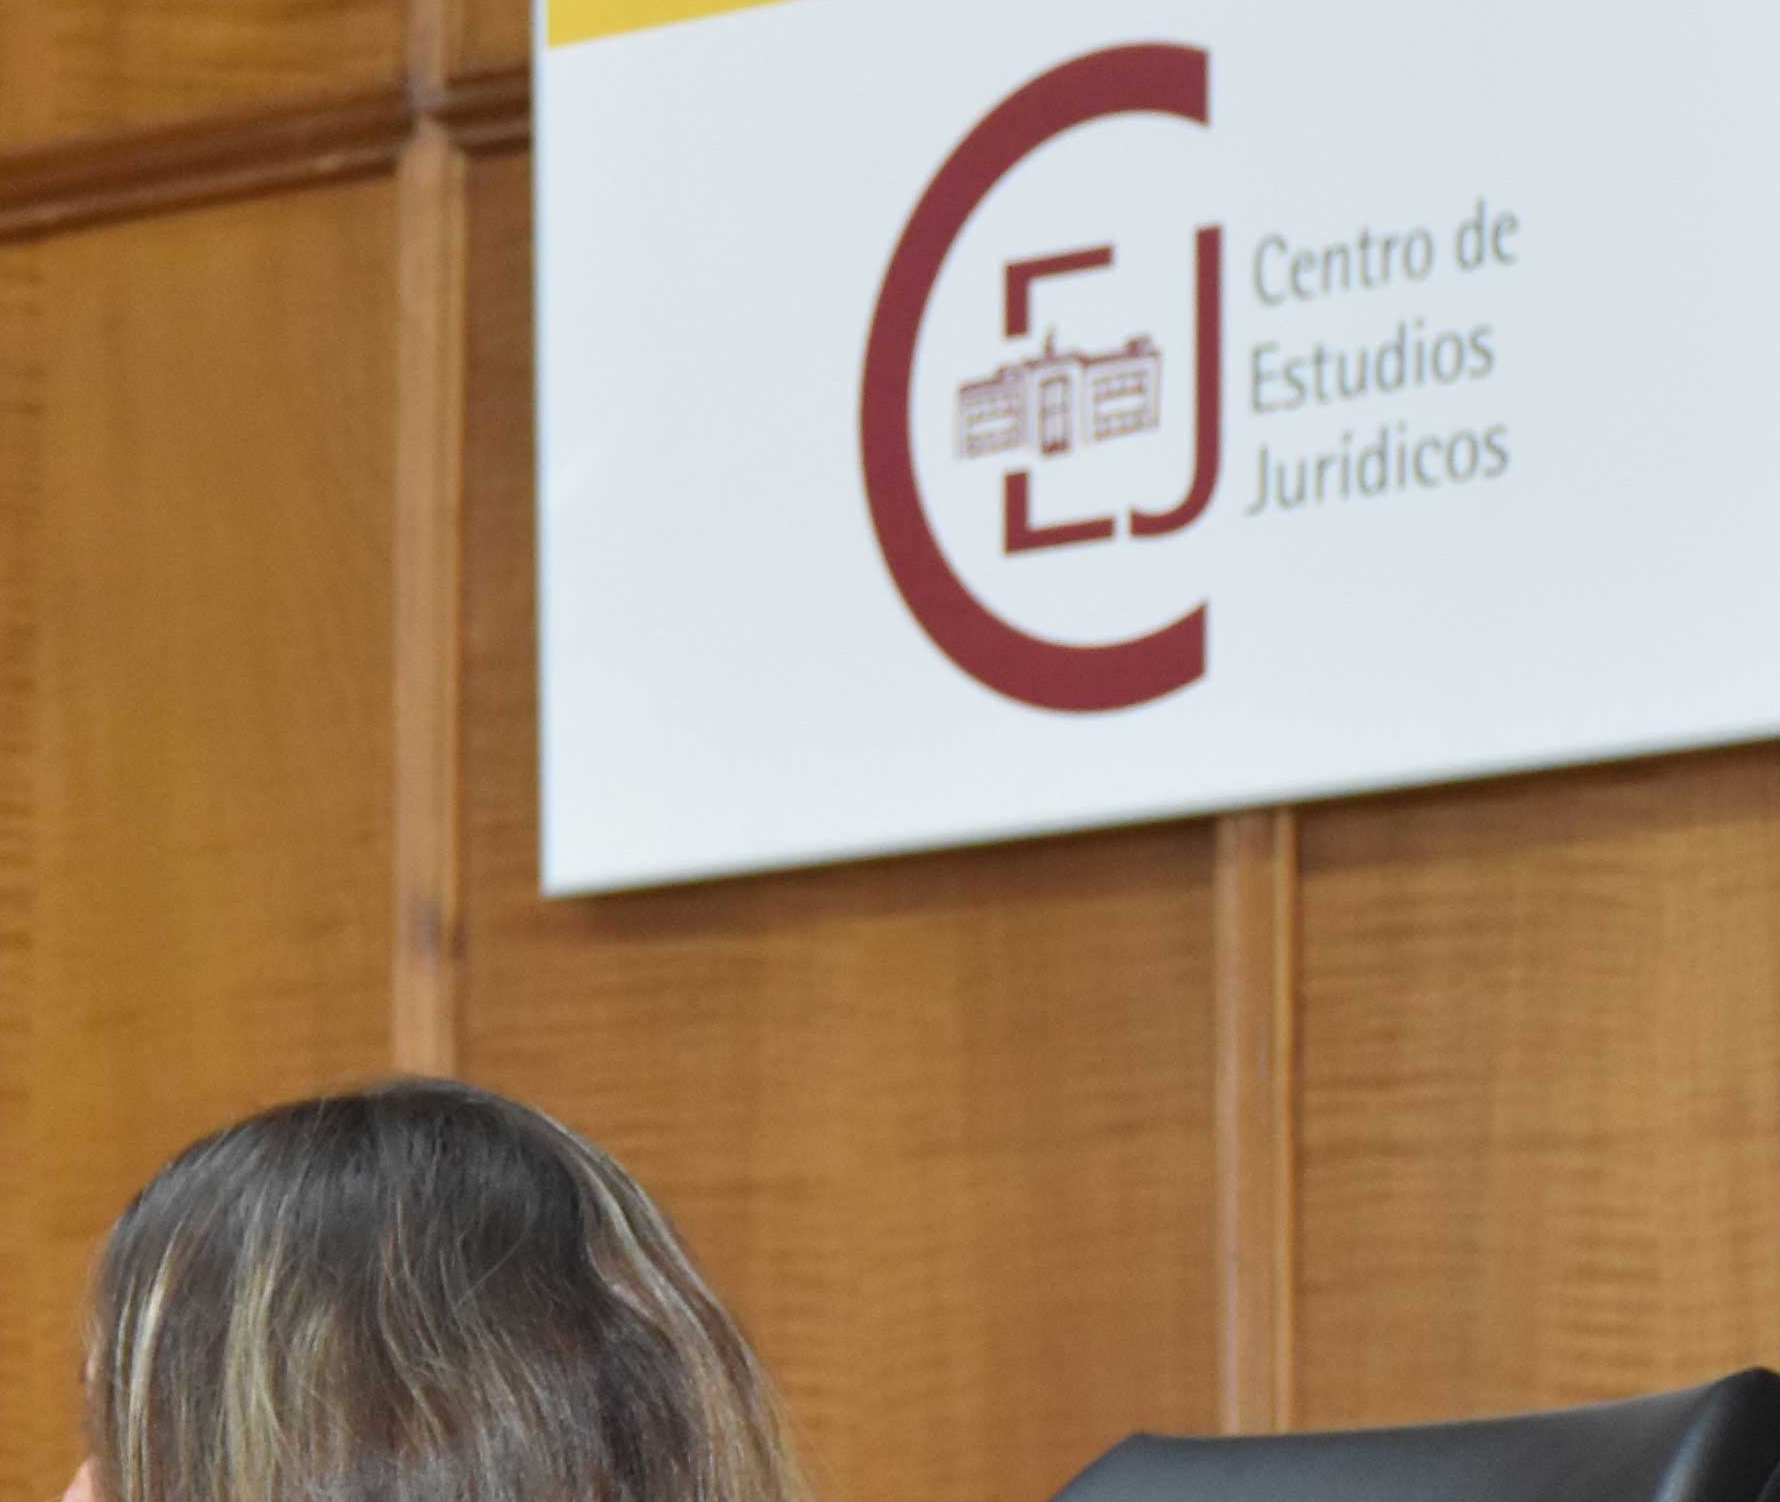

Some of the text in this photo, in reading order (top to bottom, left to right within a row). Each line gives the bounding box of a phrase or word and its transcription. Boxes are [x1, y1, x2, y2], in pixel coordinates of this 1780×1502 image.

[1252, 195, 1520, 307] Centro de
[1250, 316, 1496, 414] Estudios
[1245, 420, 1511, 516] Jurídicos
